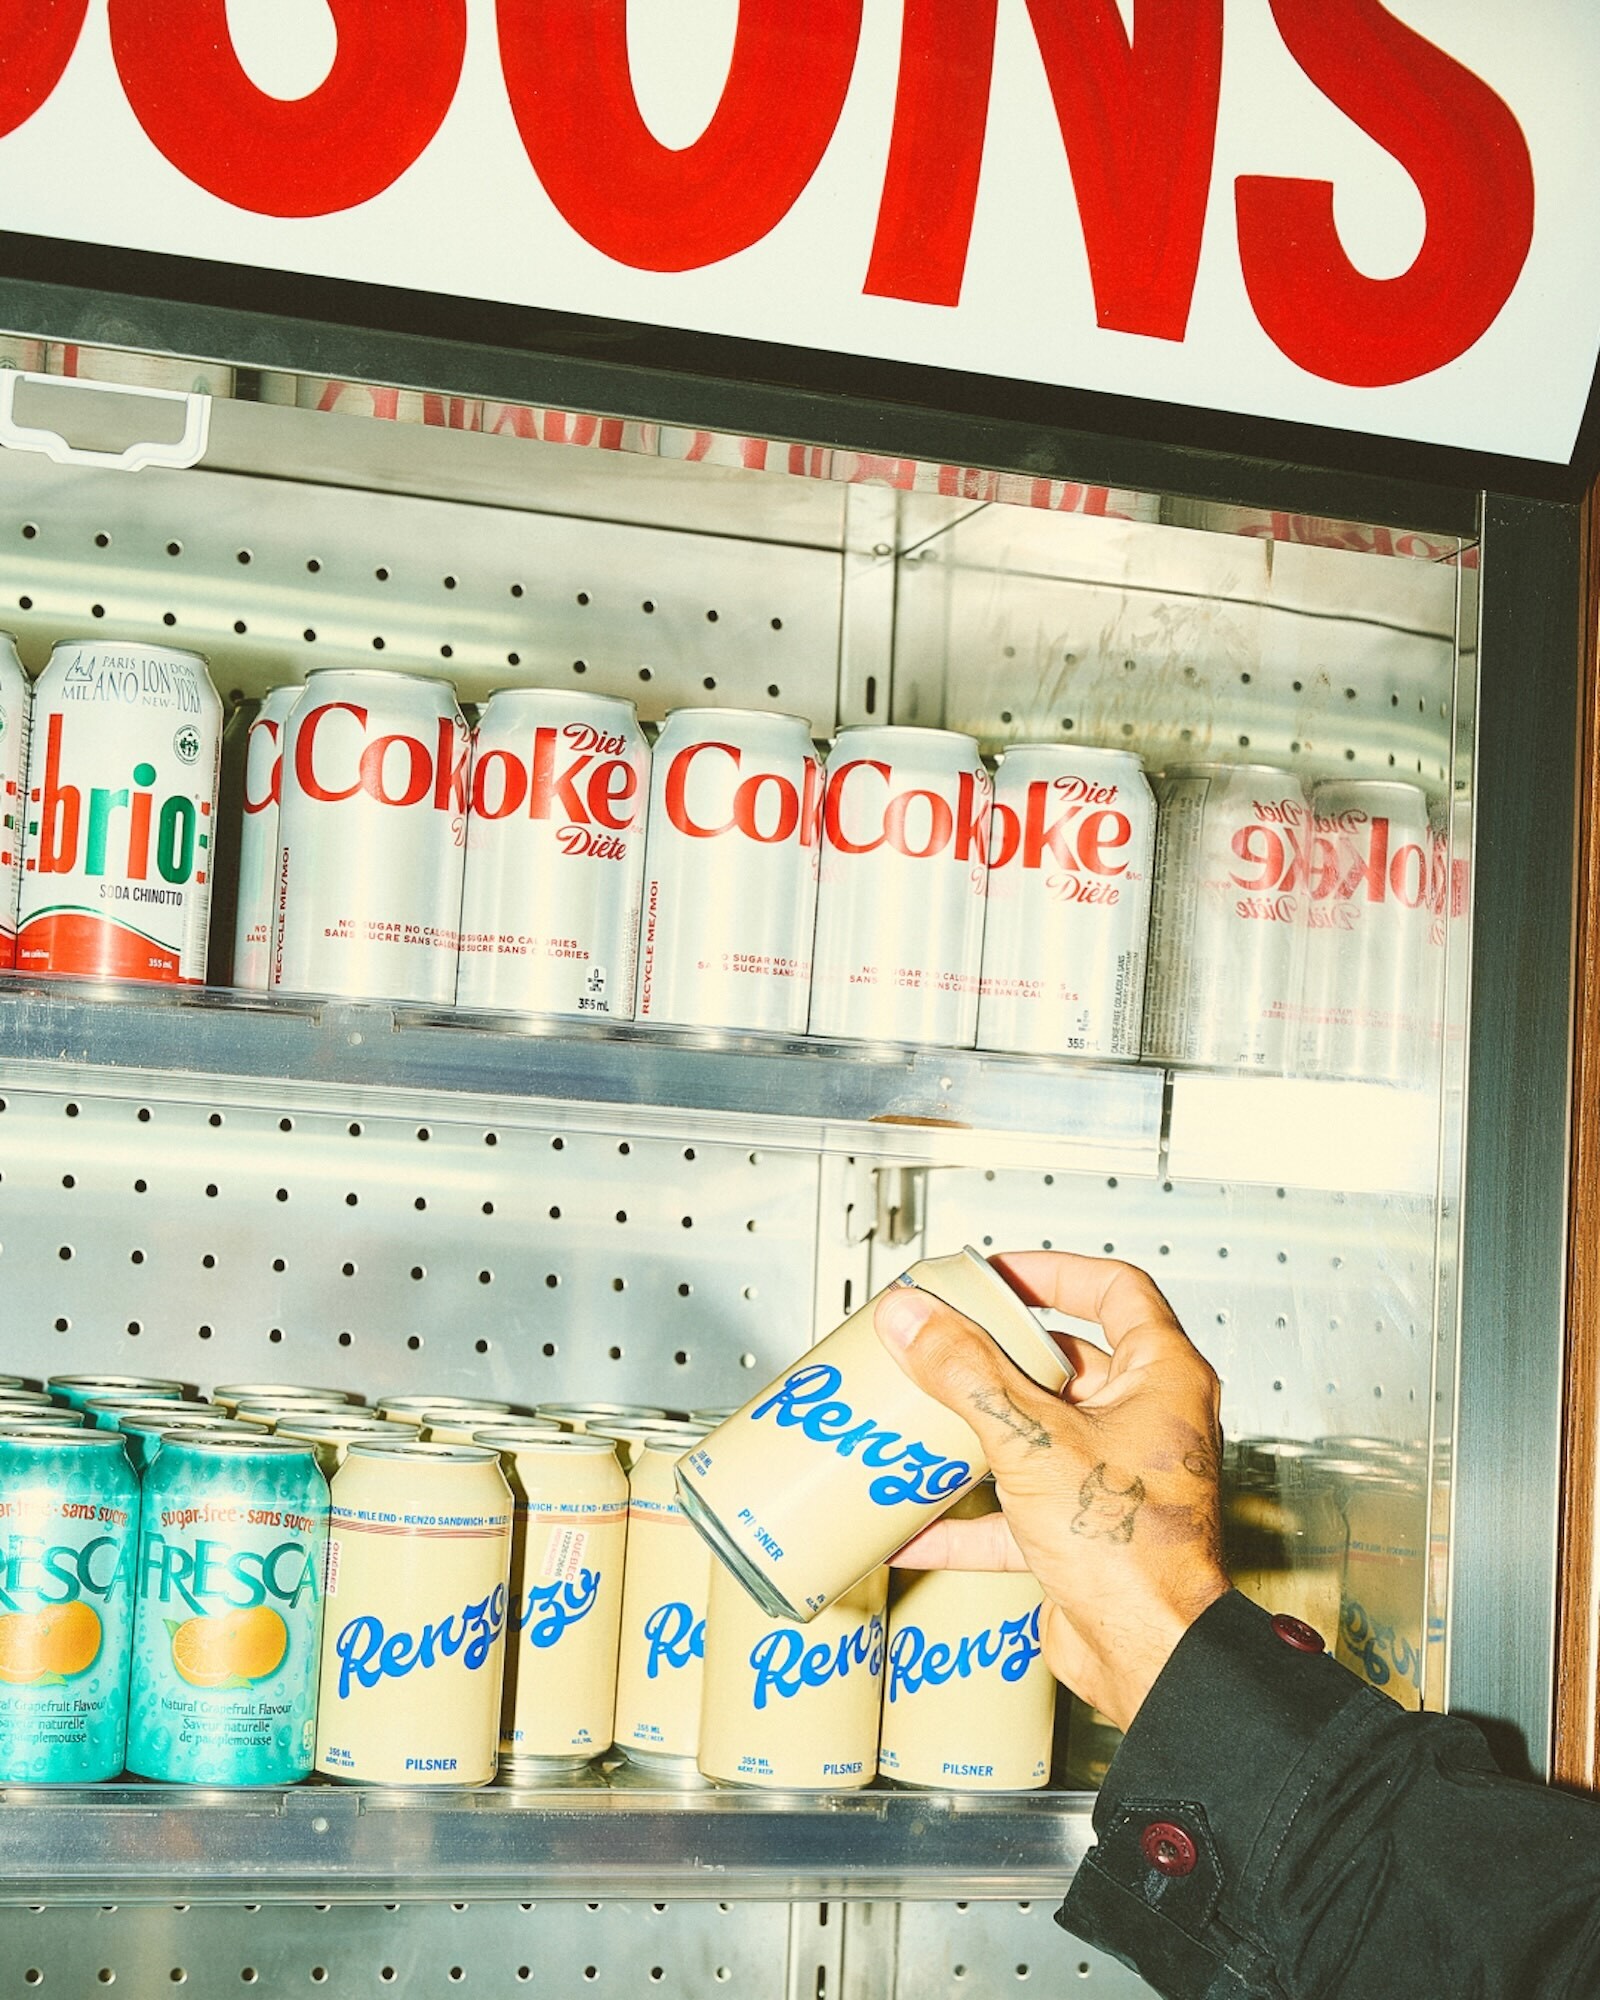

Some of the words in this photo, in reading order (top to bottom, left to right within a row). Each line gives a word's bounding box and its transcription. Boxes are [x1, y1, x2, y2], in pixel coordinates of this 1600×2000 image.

[0, 0, 1534, 388] ONS
[102, 655, 136, 670] PARIS
[563, 722, 627, 756] Diet
[295, 702, 470, 815] Cok
[471, 727, 638, 830] oke
[1053, 775, 1120, 805] Diet
[39, 714, 197, 885] brio
[665, 741, 827, 848] Cok
[824, 759, 989, 869] Cok
[988, 780, 1132, 876] oke
[556, 825, 627, 862] Diète
[279, 846, 290, 911] ME/MOI
[1046, 872, 1121, 907] Diète
[99, 883, 130, 901] SODA
[132, 887, 184, 907] CHINOTTO
[338, 919, 356, 929] NO
[363, 921, 402, 933] UGAR
[405, 924, 421, 935] NO
[647, 881, 659, 943] ME/MOI
[247, 934, 267, 943] SANS
[275, 912, 286, 985] RECYCLE
[324, 928, 355, 940] SANS
[364, 932, 400, 943] UCRE
[403, 934, 431, 946] SANS
[467, 933, 495, 944] SUGAR
[498, 935, 515, 945] NO
[467, 944, 494, 954] SUCRE
[497, 945, 527, 955] SANS
[732, 964, 770, 976] SUCRE
[772, 967, 795, 978] SANS
[733, 953, 771, 965] SUGAR
[773, 957, 787, 968] NO
[642, 945, 654, 1014] RECYCLE
[578, 996, 596, 1010] 355
[596, 999, 610, 1012] mL
[1067, 1037, 1085, 1050] 355
[750, 1364, 972, 1506] Renzo
[62, 1502, 96, 1520] sans
[97, 1506, 129, 1527] sucre
[161, 1503, 237, 1531] sugar-free
[247, 1507, 281, 1527] sans
[283, 1511, 315, 1534] sucre
[358, 1510, 377, 1521] MILE
[378, 1512, 397, 1523] END
[404, 1514, 436, 1525] RENZO
[437, 1516, 484, 1527] SANDWICH
[560, 1503, 580, 1513] MILE
[581, 1503, 597, 1513] END
[0, 1533, 135, 1612] ESCA
[565, 1533, 585, 1582] QUÉBEC
[139, 1531, 320, 1616] FRESCA
[336, 1582, 506, 1700] Renzo
[889, 1603, 1041, 1704] Renz
[161, 1697, 197, 1712] Natural
[200, 1701, 256, 1716] Grapefruit
[258, 1702, 292, 1716] Flavour
[38, 1717, 85, 1730] naturelle
[179, 1731, 192, 1743] de
[224, 1718, 270, 1733] naturelle
[405, 1758, 457, 1771] PILSNER
[823, 1762, 864, 1776] PILSNER
[942, 1762, 994, 1777] PILSNER
